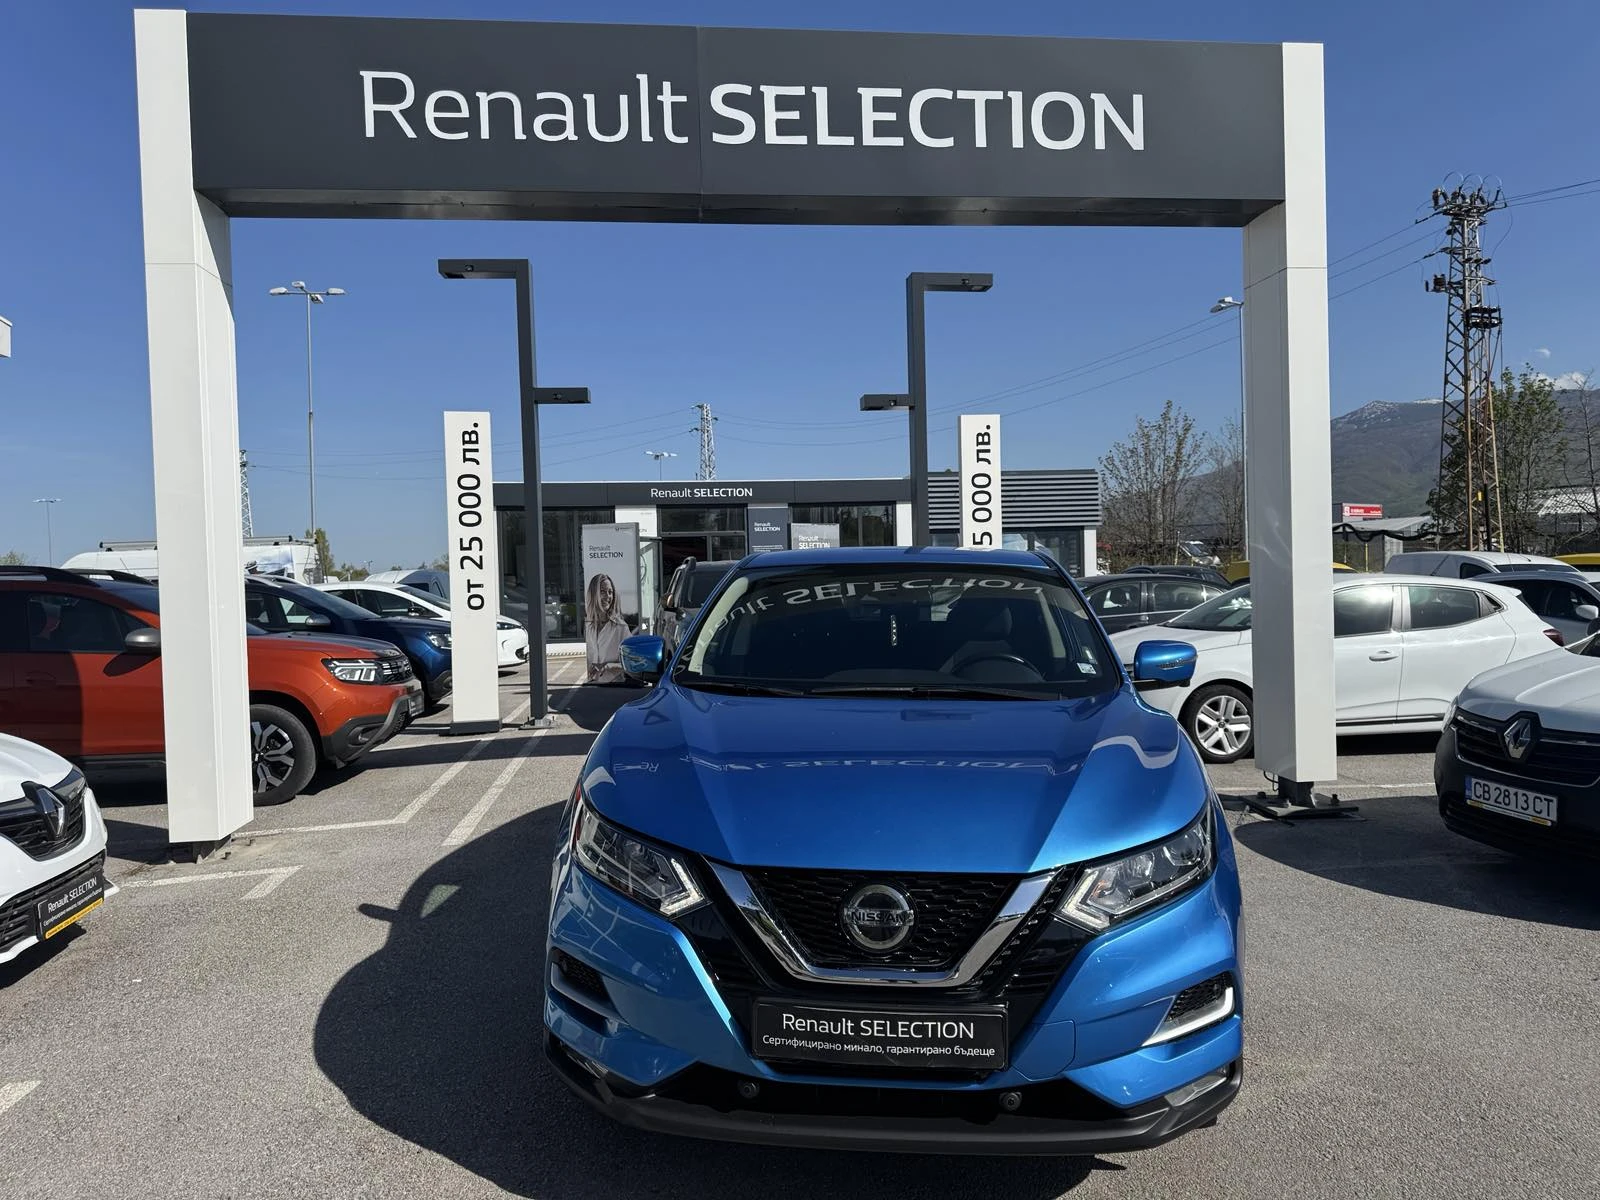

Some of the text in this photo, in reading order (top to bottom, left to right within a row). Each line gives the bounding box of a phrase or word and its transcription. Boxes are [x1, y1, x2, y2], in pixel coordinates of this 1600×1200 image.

[360, 70, 1146, 151] Renault SELECTION
[976, 424, 991, 464] лв.
[650, 487, 753, 498] Renault SELECTION
[971, 472, 992, 523] 000
[457, 422, 485, 610] от 25 000 лв.
[588, 551, 624, 559] SELECTION
[798, 541, 831, 550] SELECTION
[1473, 781, 1491, 801] CB
[1494, 786, 1529, 811] 2813
[1532, 795, 1554, 818] CT
[48, 893, 69, 914] Renault
[69, 876, 97, 901] SELECTION
[851, 911, 906, 923] NISSAN
[782, 1013, 974, 1040] Renault SELECTION
[762, 1034, 996, 1058] Сертифицирано минало, гарантирано бъдеще
